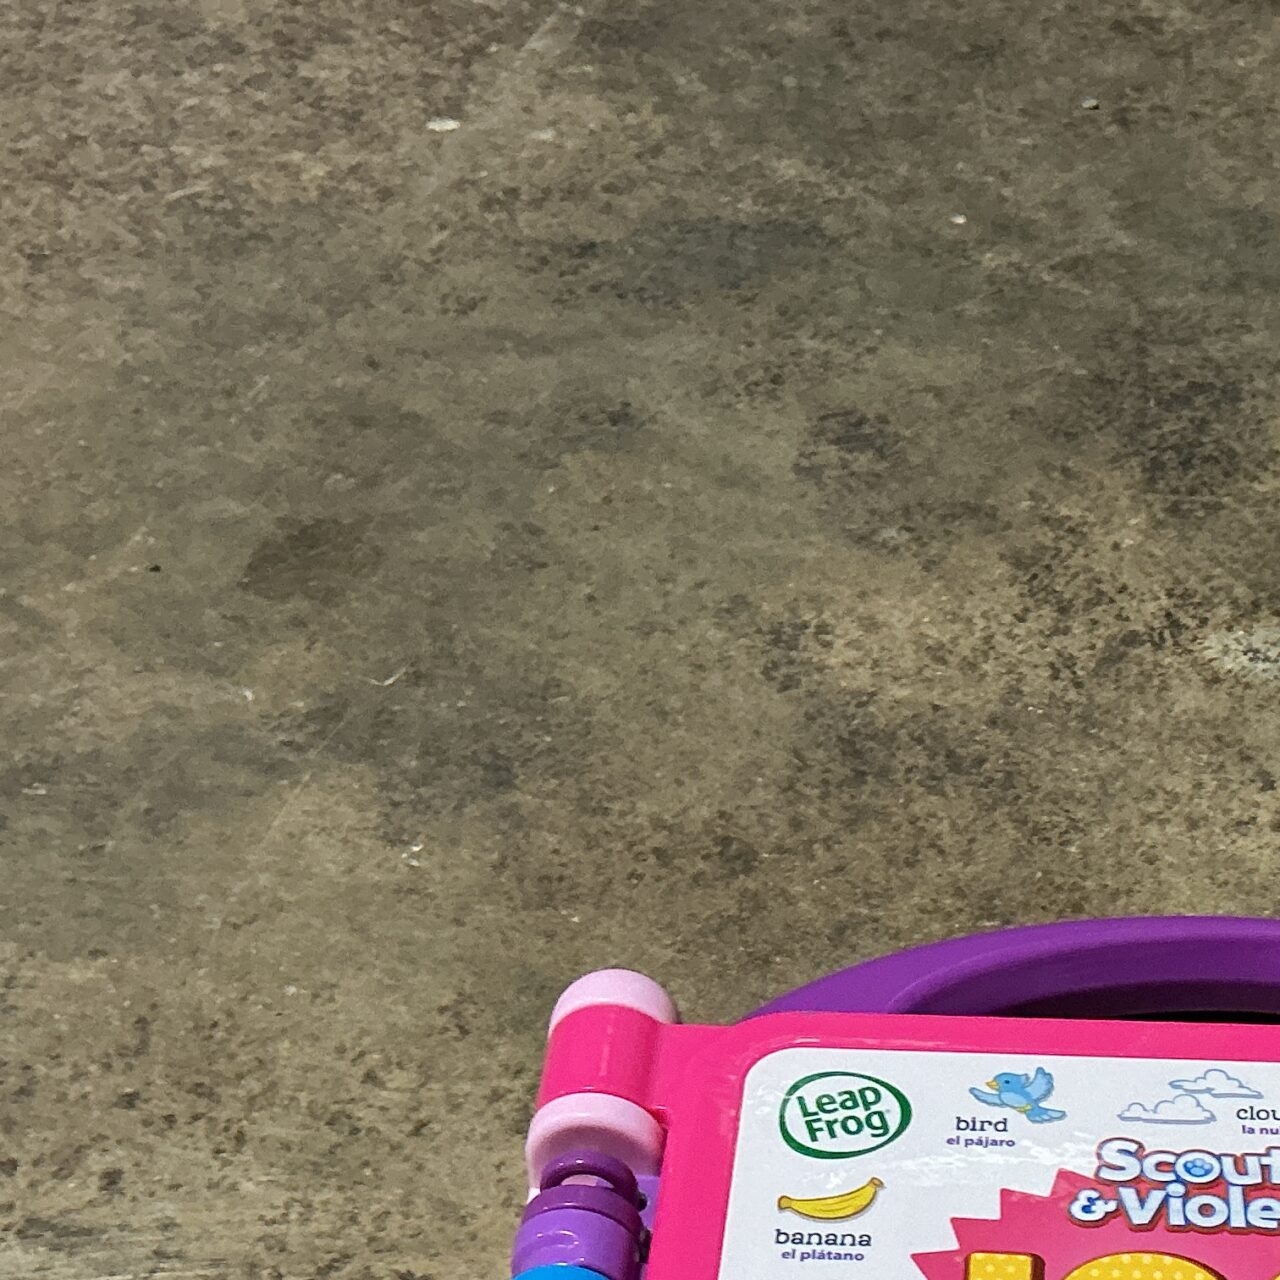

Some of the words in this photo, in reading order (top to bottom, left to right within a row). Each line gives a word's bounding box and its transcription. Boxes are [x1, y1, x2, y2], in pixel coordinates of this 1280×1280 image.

[797, 1085, 883, 1118] Leap
[803, 1109, 890, 1143] Frog
[955, 1116, 1009, 1132] bird
[1241, 1124, 1255, 1135] la
[946, 1136, 961, 1146] el
[964, 1135, 1016, 1147] pájaro
[775, 1228, 872, 1247] banana
[781, 1250, 796, 1261] el
[800, 1249, 865, 1262] plátano
